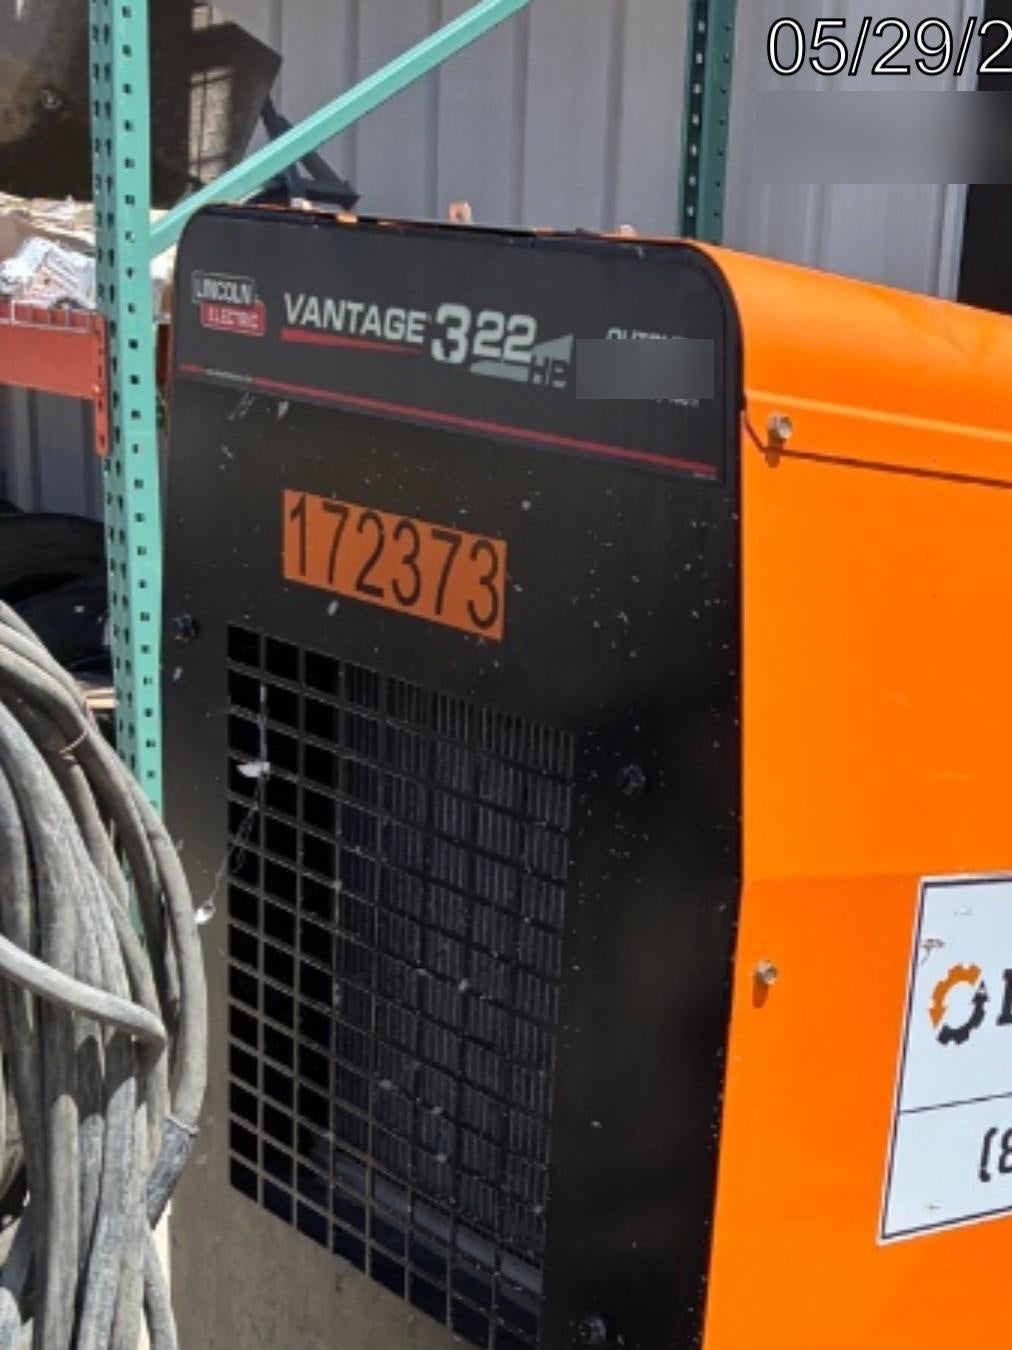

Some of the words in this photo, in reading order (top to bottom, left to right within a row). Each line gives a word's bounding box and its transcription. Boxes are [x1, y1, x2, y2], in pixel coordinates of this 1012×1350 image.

[197, 278, 254, 305] LINCOLN
[207, 306, 260, 328] ELECTRIC
[284, 292, 426, 344] VANTAGE
[290, 494, 499, 629] 172373
